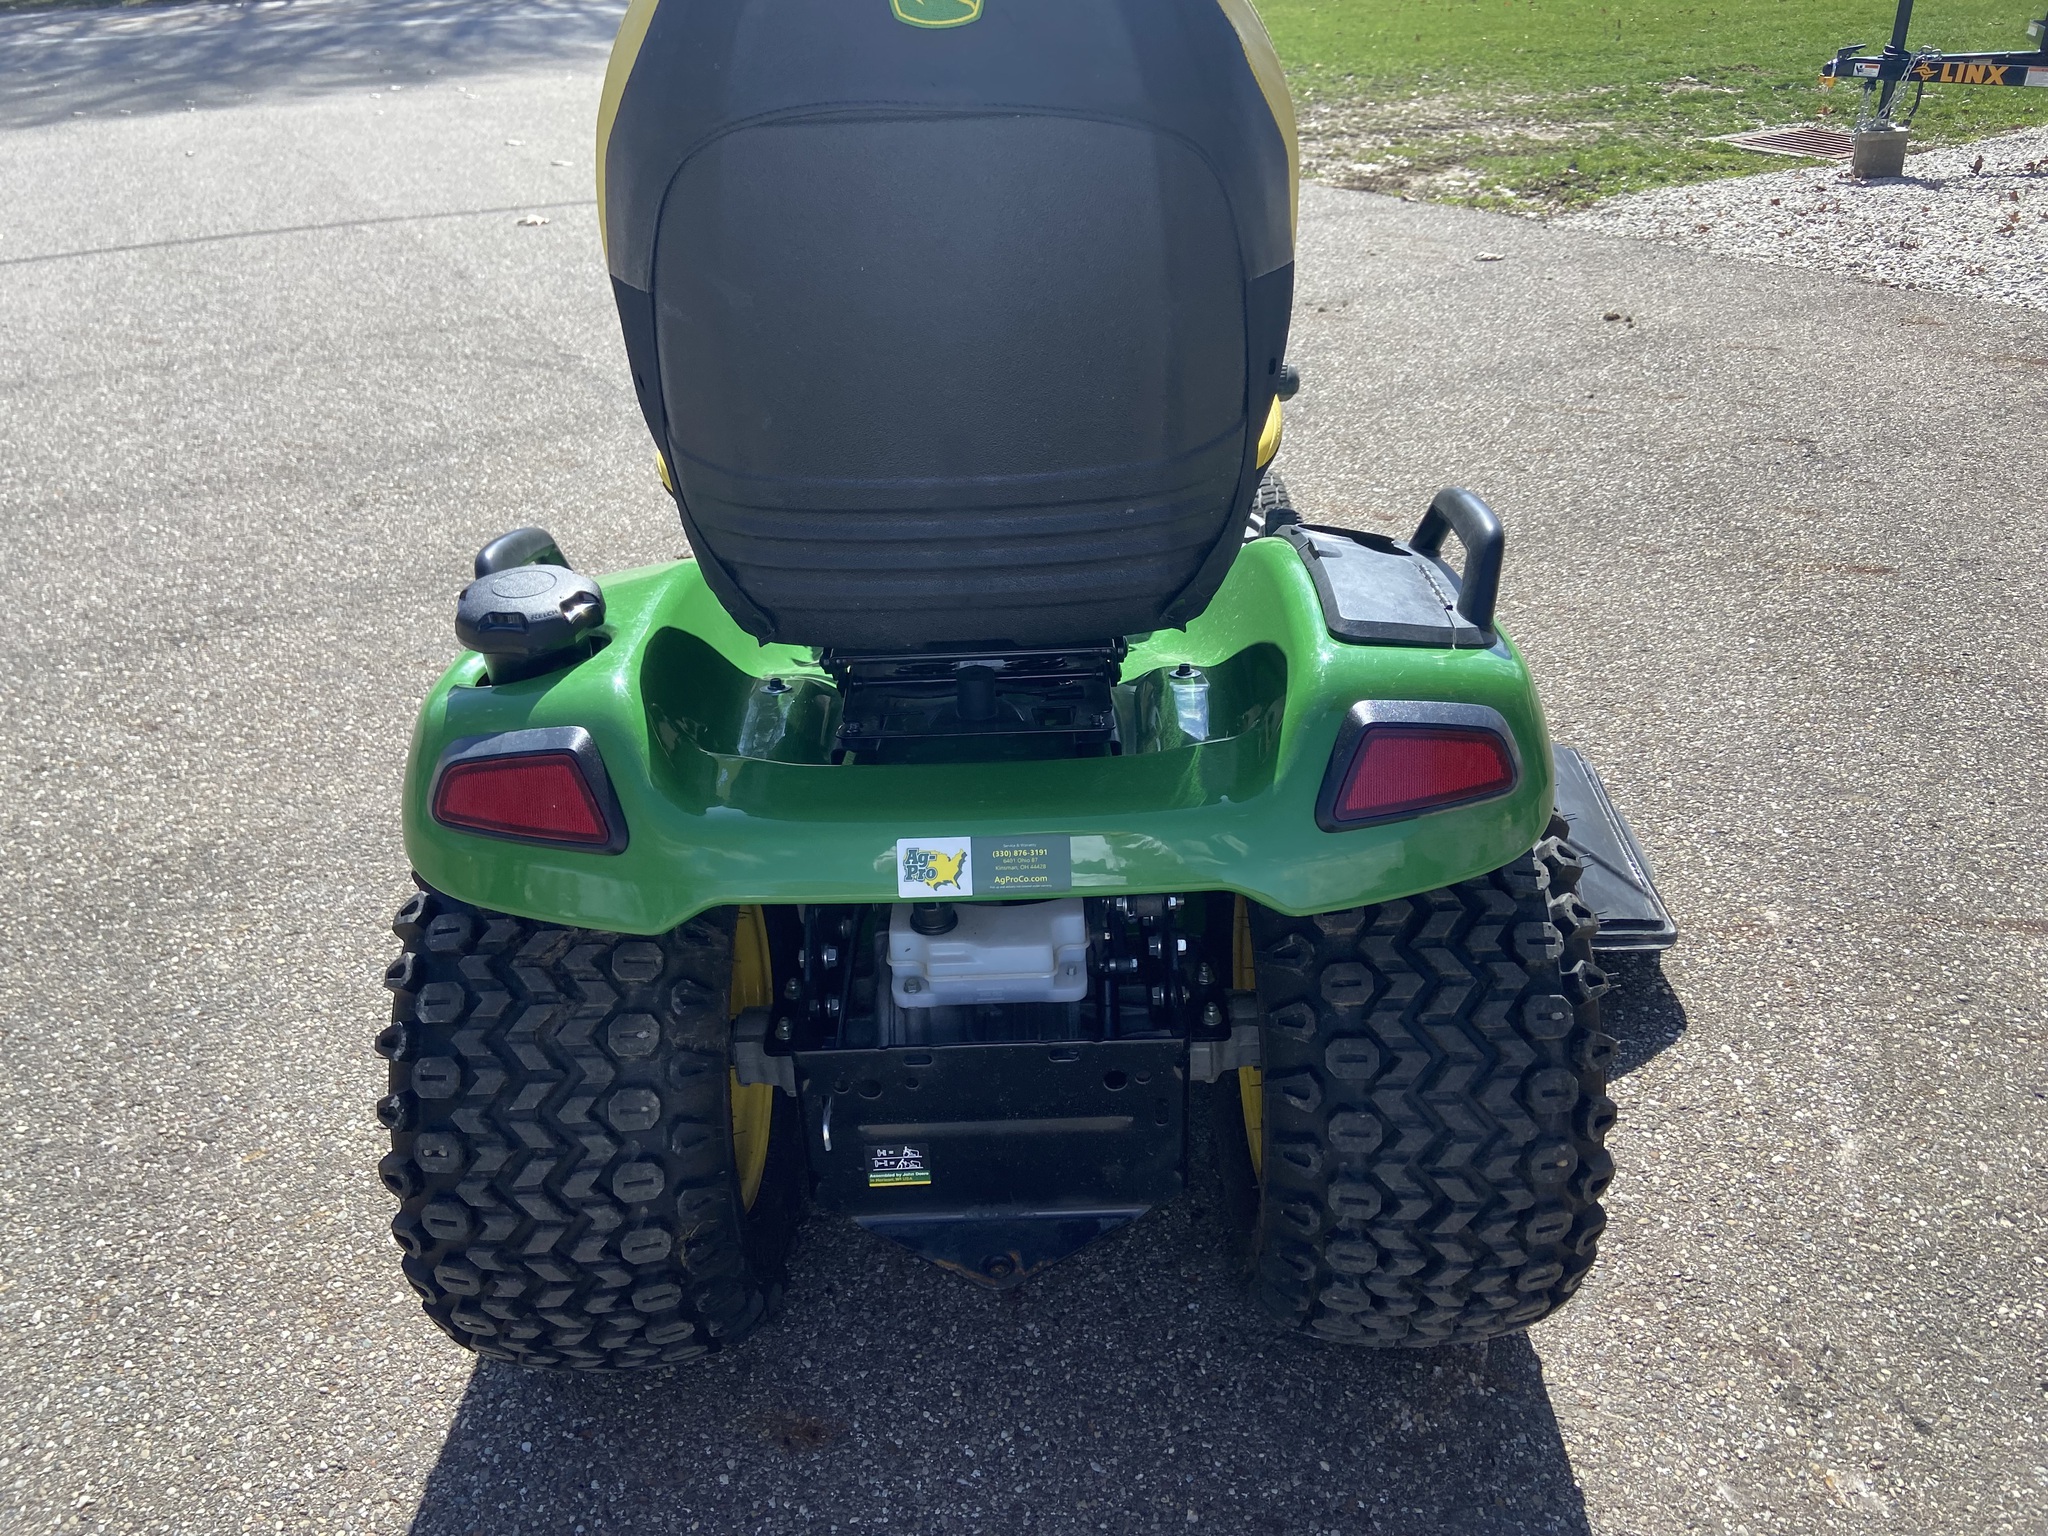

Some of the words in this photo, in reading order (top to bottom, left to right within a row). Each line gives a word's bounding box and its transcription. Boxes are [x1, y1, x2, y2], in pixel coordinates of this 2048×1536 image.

[1939, 62, 2009, 85] LINX
[903, 847, 937, 868] Ag-
[992, 850, 1012, 858] (330)
[1013, 849, 1048, 857] 876-3191
[904, 865, 938, 882] Pro
[994, 875, 1048, 885] AgProCo.com
